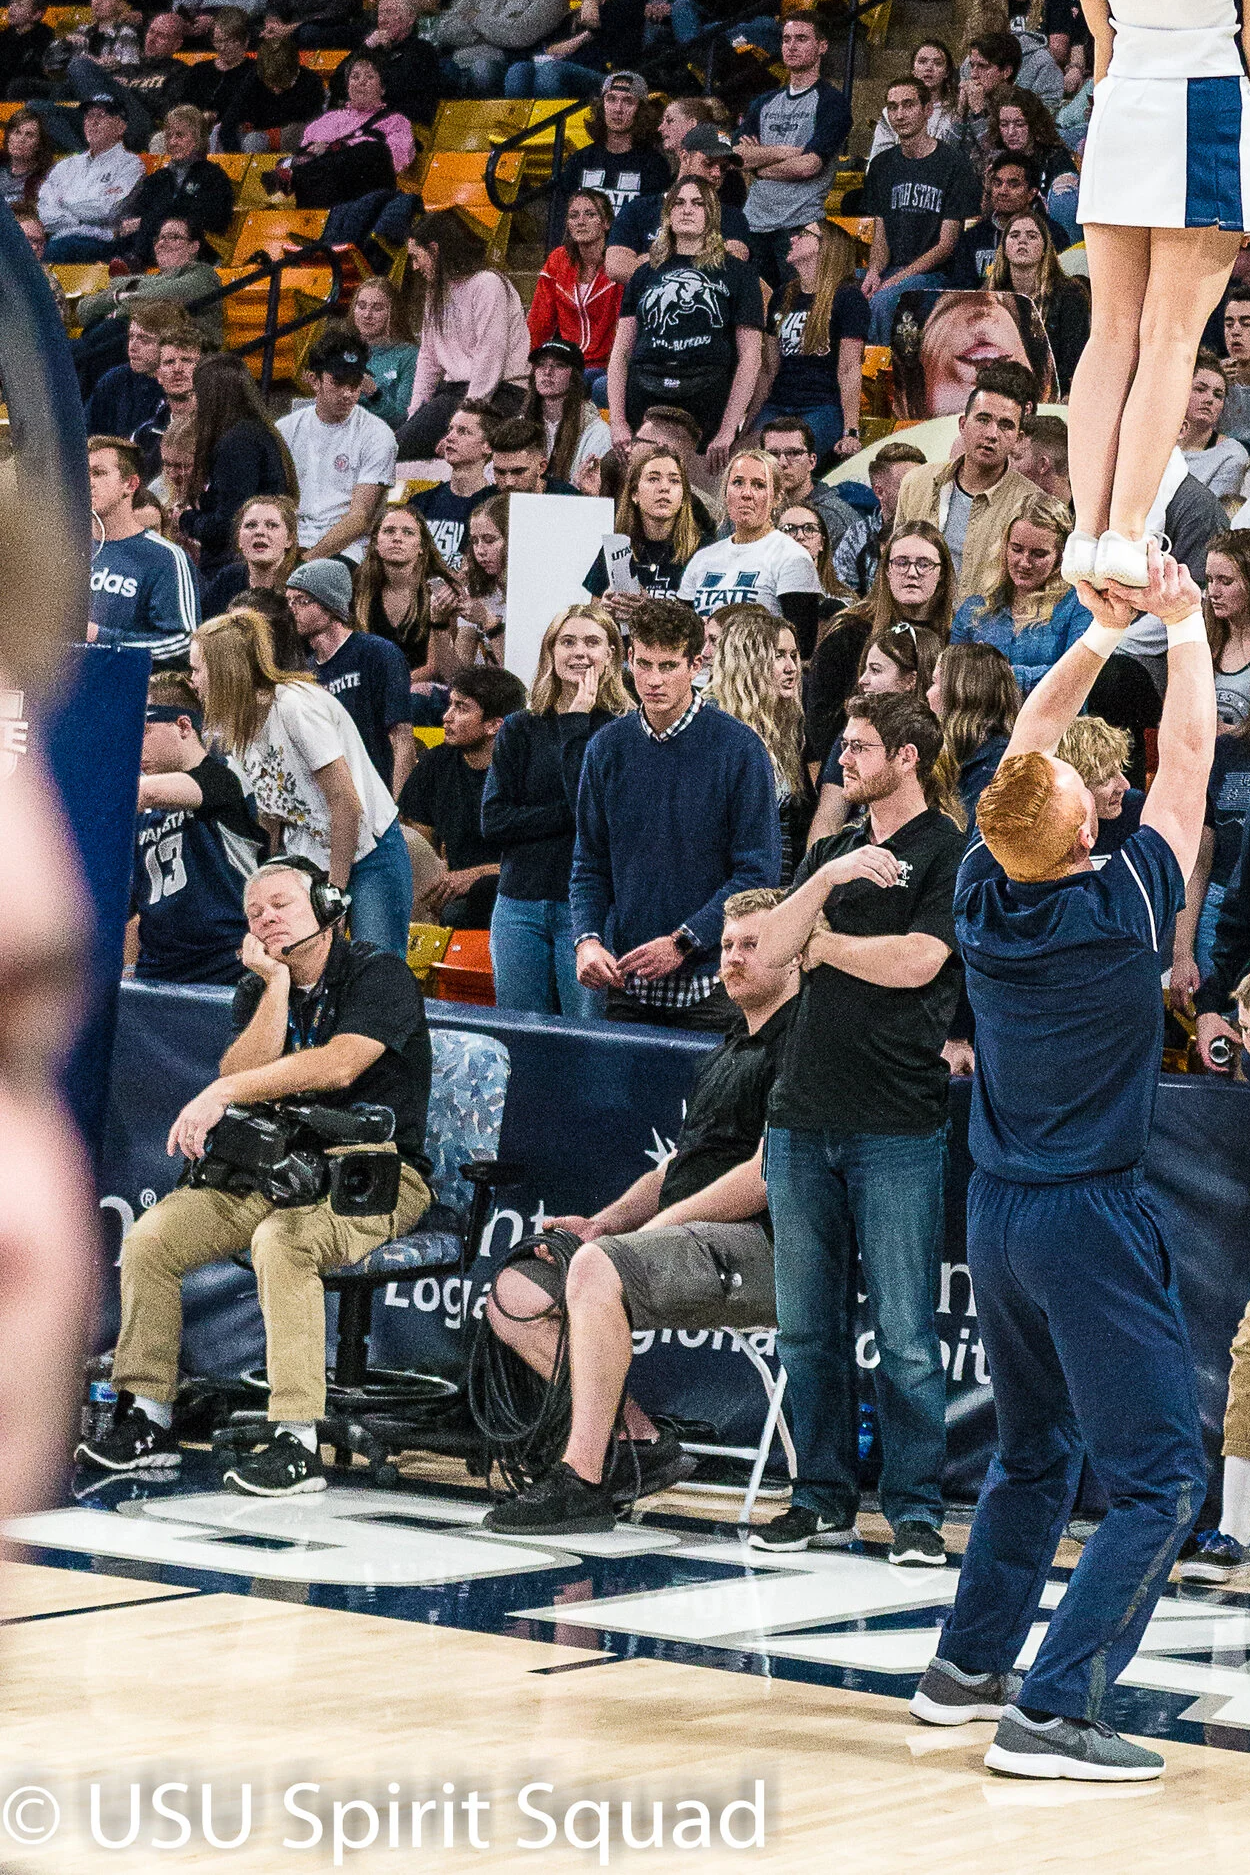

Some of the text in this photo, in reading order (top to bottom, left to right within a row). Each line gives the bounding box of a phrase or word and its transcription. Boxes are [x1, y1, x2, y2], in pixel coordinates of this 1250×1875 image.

[90, 567, 138, 598] das
[692, 589, 759, 609] STATE
[145, 832, 188, 906] 13
